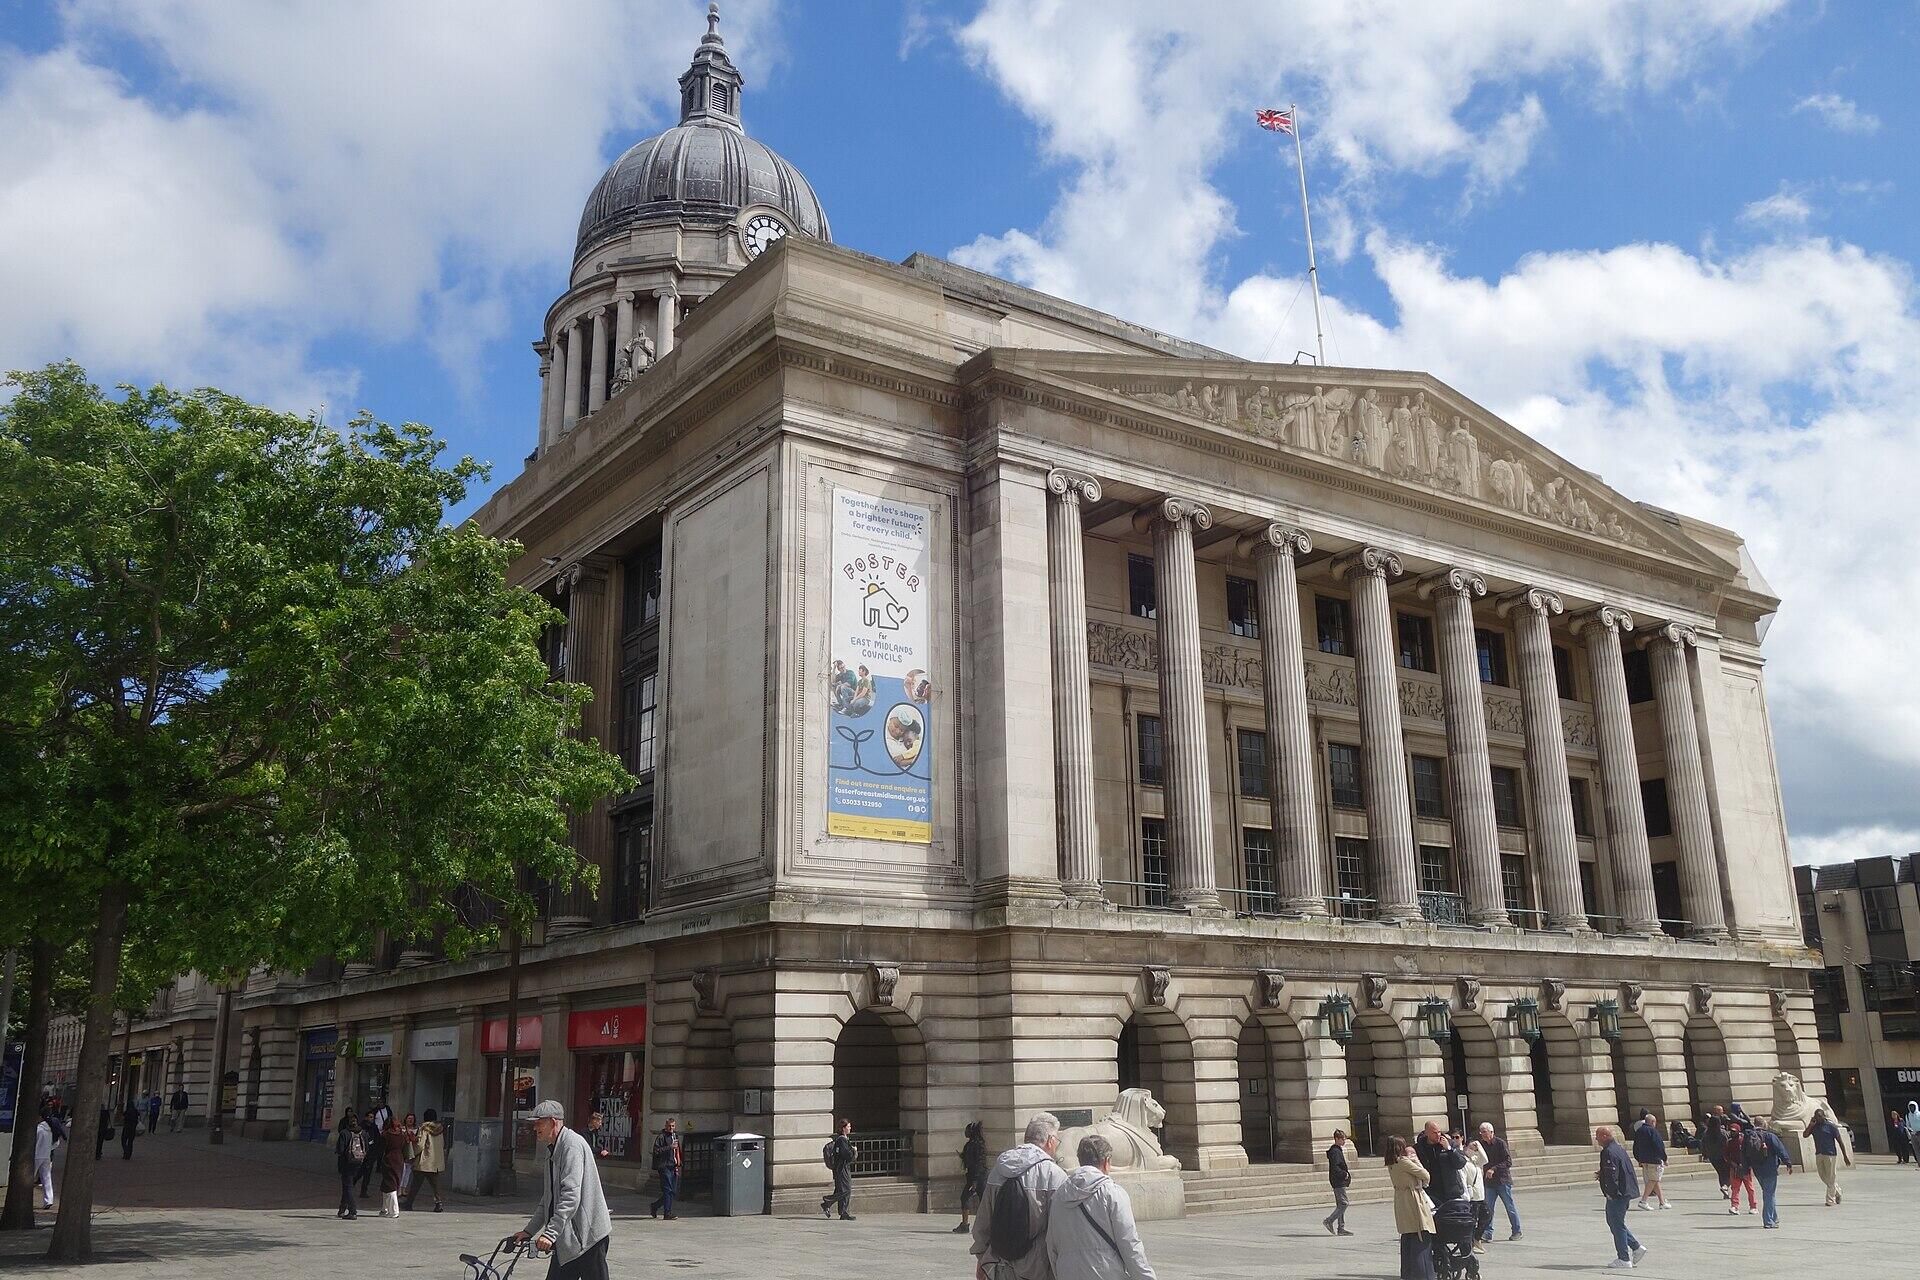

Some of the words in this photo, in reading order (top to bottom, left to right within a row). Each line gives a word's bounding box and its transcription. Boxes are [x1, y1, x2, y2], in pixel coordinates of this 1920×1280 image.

[841, 496, 880, 512] Together,
[881, 505, 899, 515] let's
[900, 510, 924, 522] shape
[853, 520, 865, 529] for
[866, 525, 889, 536] every
[891, 530, 912, 540] child.
[856, 510, 890, 524] brighter
[891, 519, 916, 530] future
[843, 553, 920, 592] FOSTER
[851, 636, 871, 647] EAST
[874, 640, 913, 656] MIDLANDS
[862, 649, 903, 663] COUNCILS
[835, 778, 849, 786] Find
[894, 785, 918, 794] enquire
[600, 1098, 621, 1117] END
